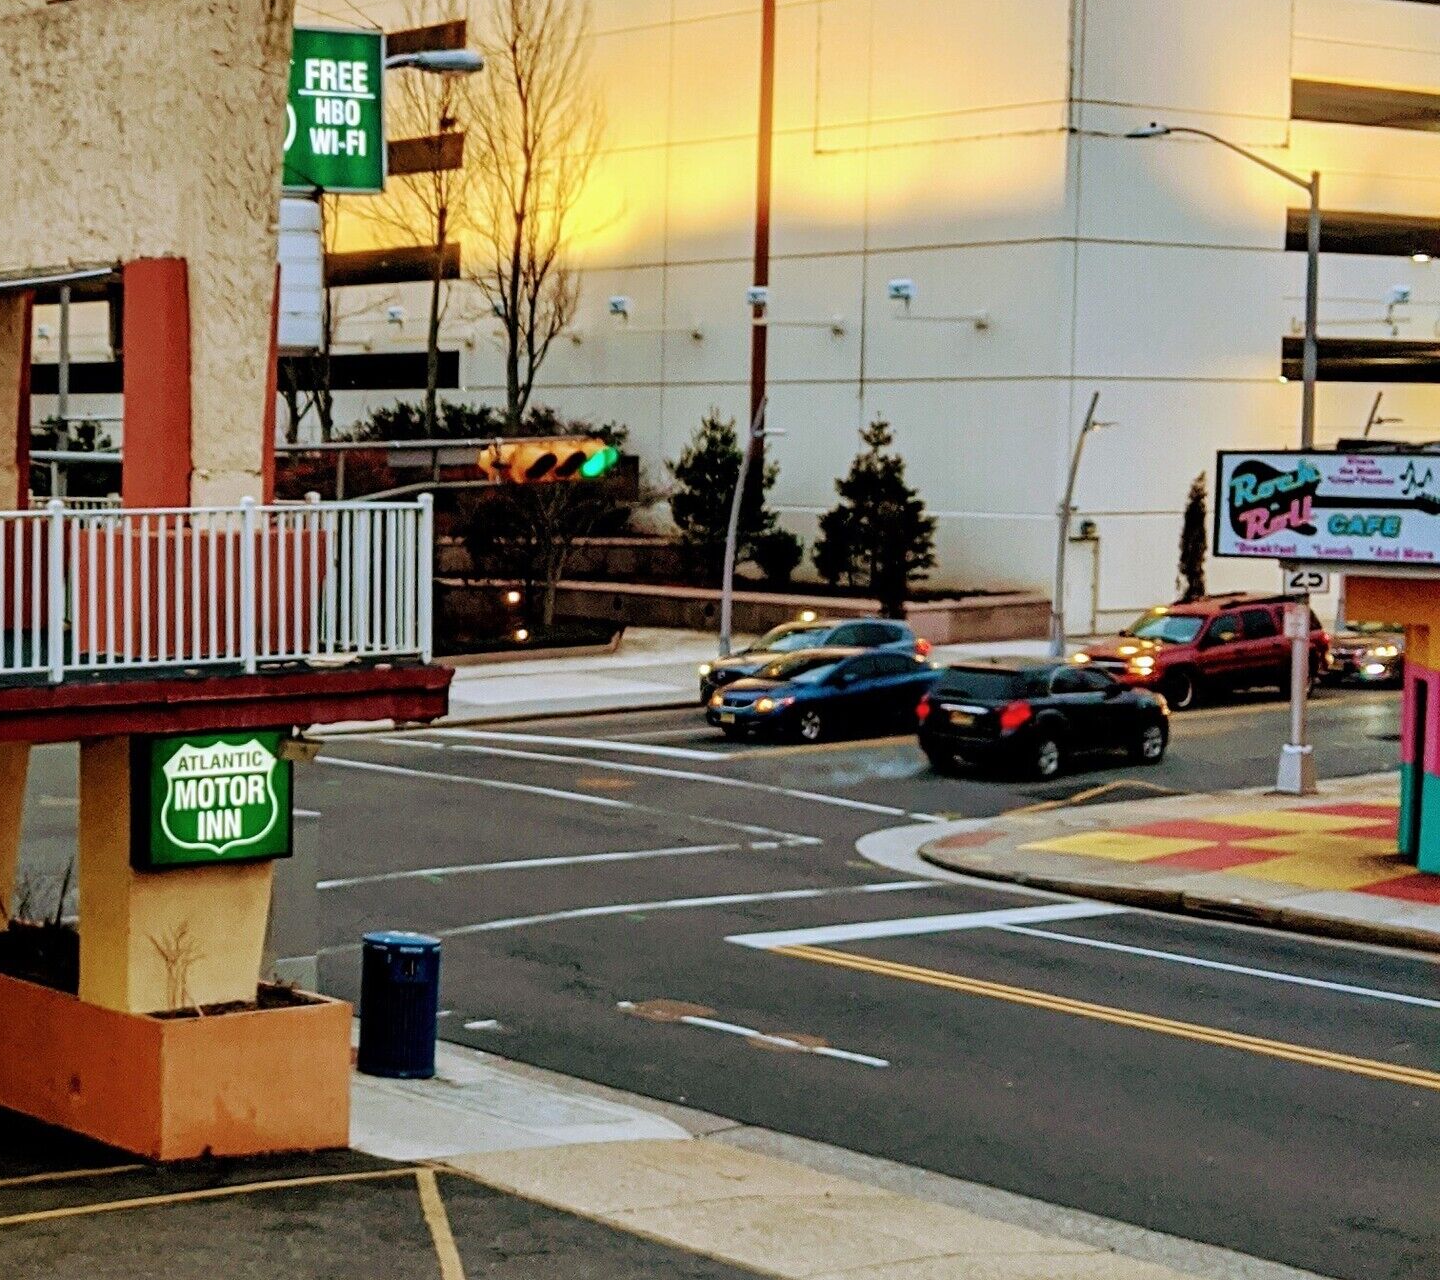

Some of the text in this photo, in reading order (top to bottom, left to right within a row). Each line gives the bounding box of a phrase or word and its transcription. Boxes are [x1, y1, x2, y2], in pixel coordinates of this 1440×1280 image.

[304, 58, 369, 93] FREE
[315, 98, 361, 127] HBO
[309, 127, 367, 157] WI-FI
[1230, 459, 1322, 507] Rock
[1238, 496, 1313, 540] Roll
[1328, 514, 1402, 538] CAFE
[177, 750, 263, 772] ATLANTIC
[174, 774, 266, 811] MOTOR
[197, 808, 242, 842] INN
